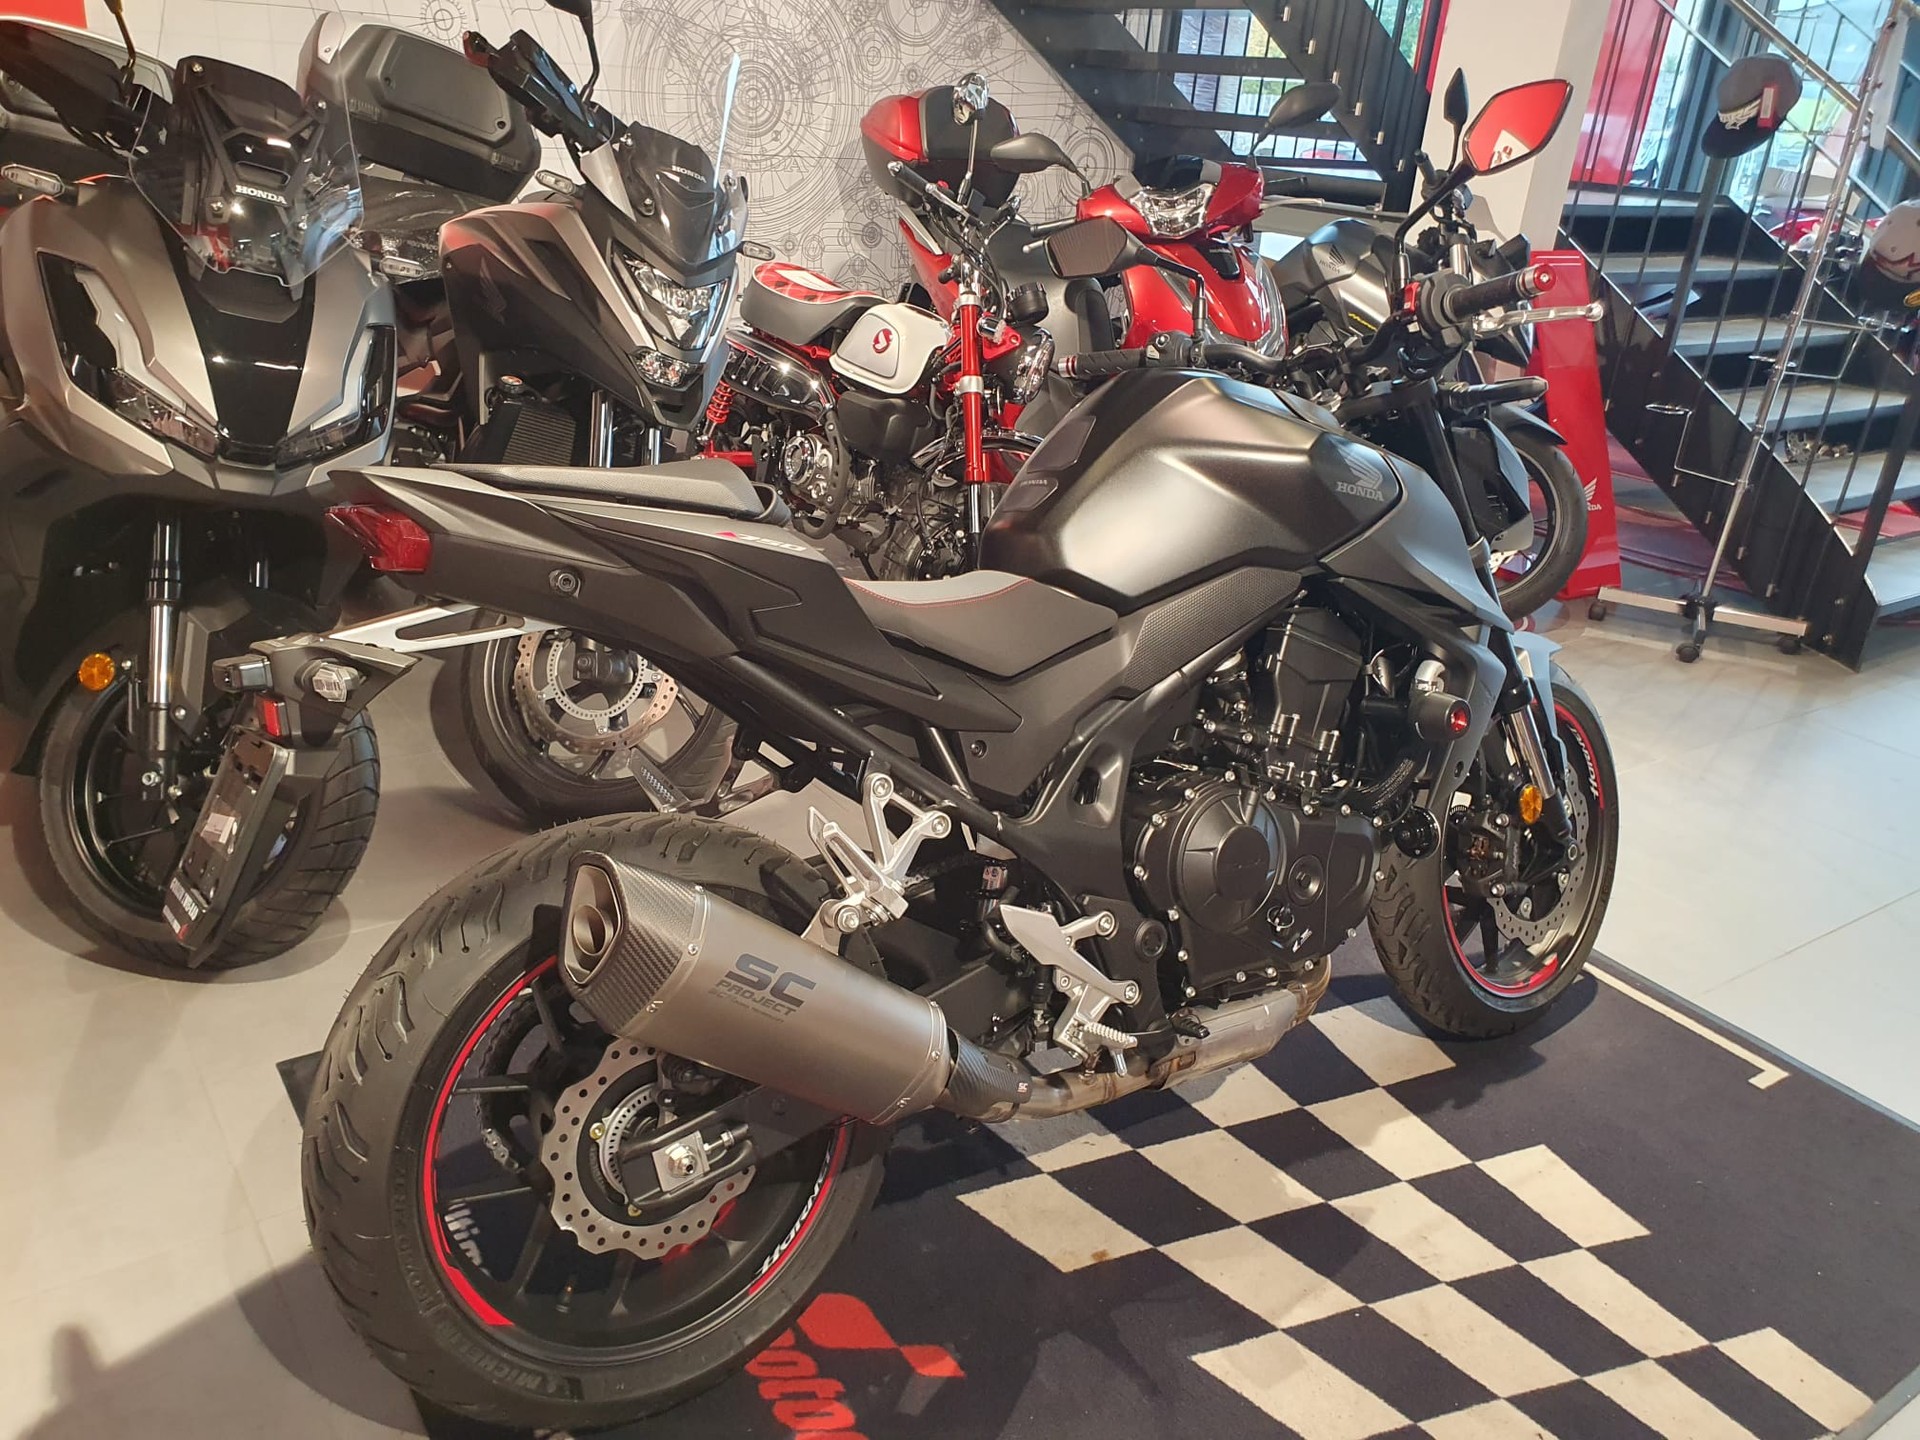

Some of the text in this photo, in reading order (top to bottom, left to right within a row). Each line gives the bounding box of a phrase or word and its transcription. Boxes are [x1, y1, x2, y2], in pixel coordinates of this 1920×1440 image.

[671, 165, 707, 184] HONDA
[235, 184, 288, 205] HONDA
[1335, 481, 1385, 501] HONDA
[738, 533, 807, 552] 750
[724, 953, 817, 1008] SC
[715, 978, 797, 1016] PROJECT
